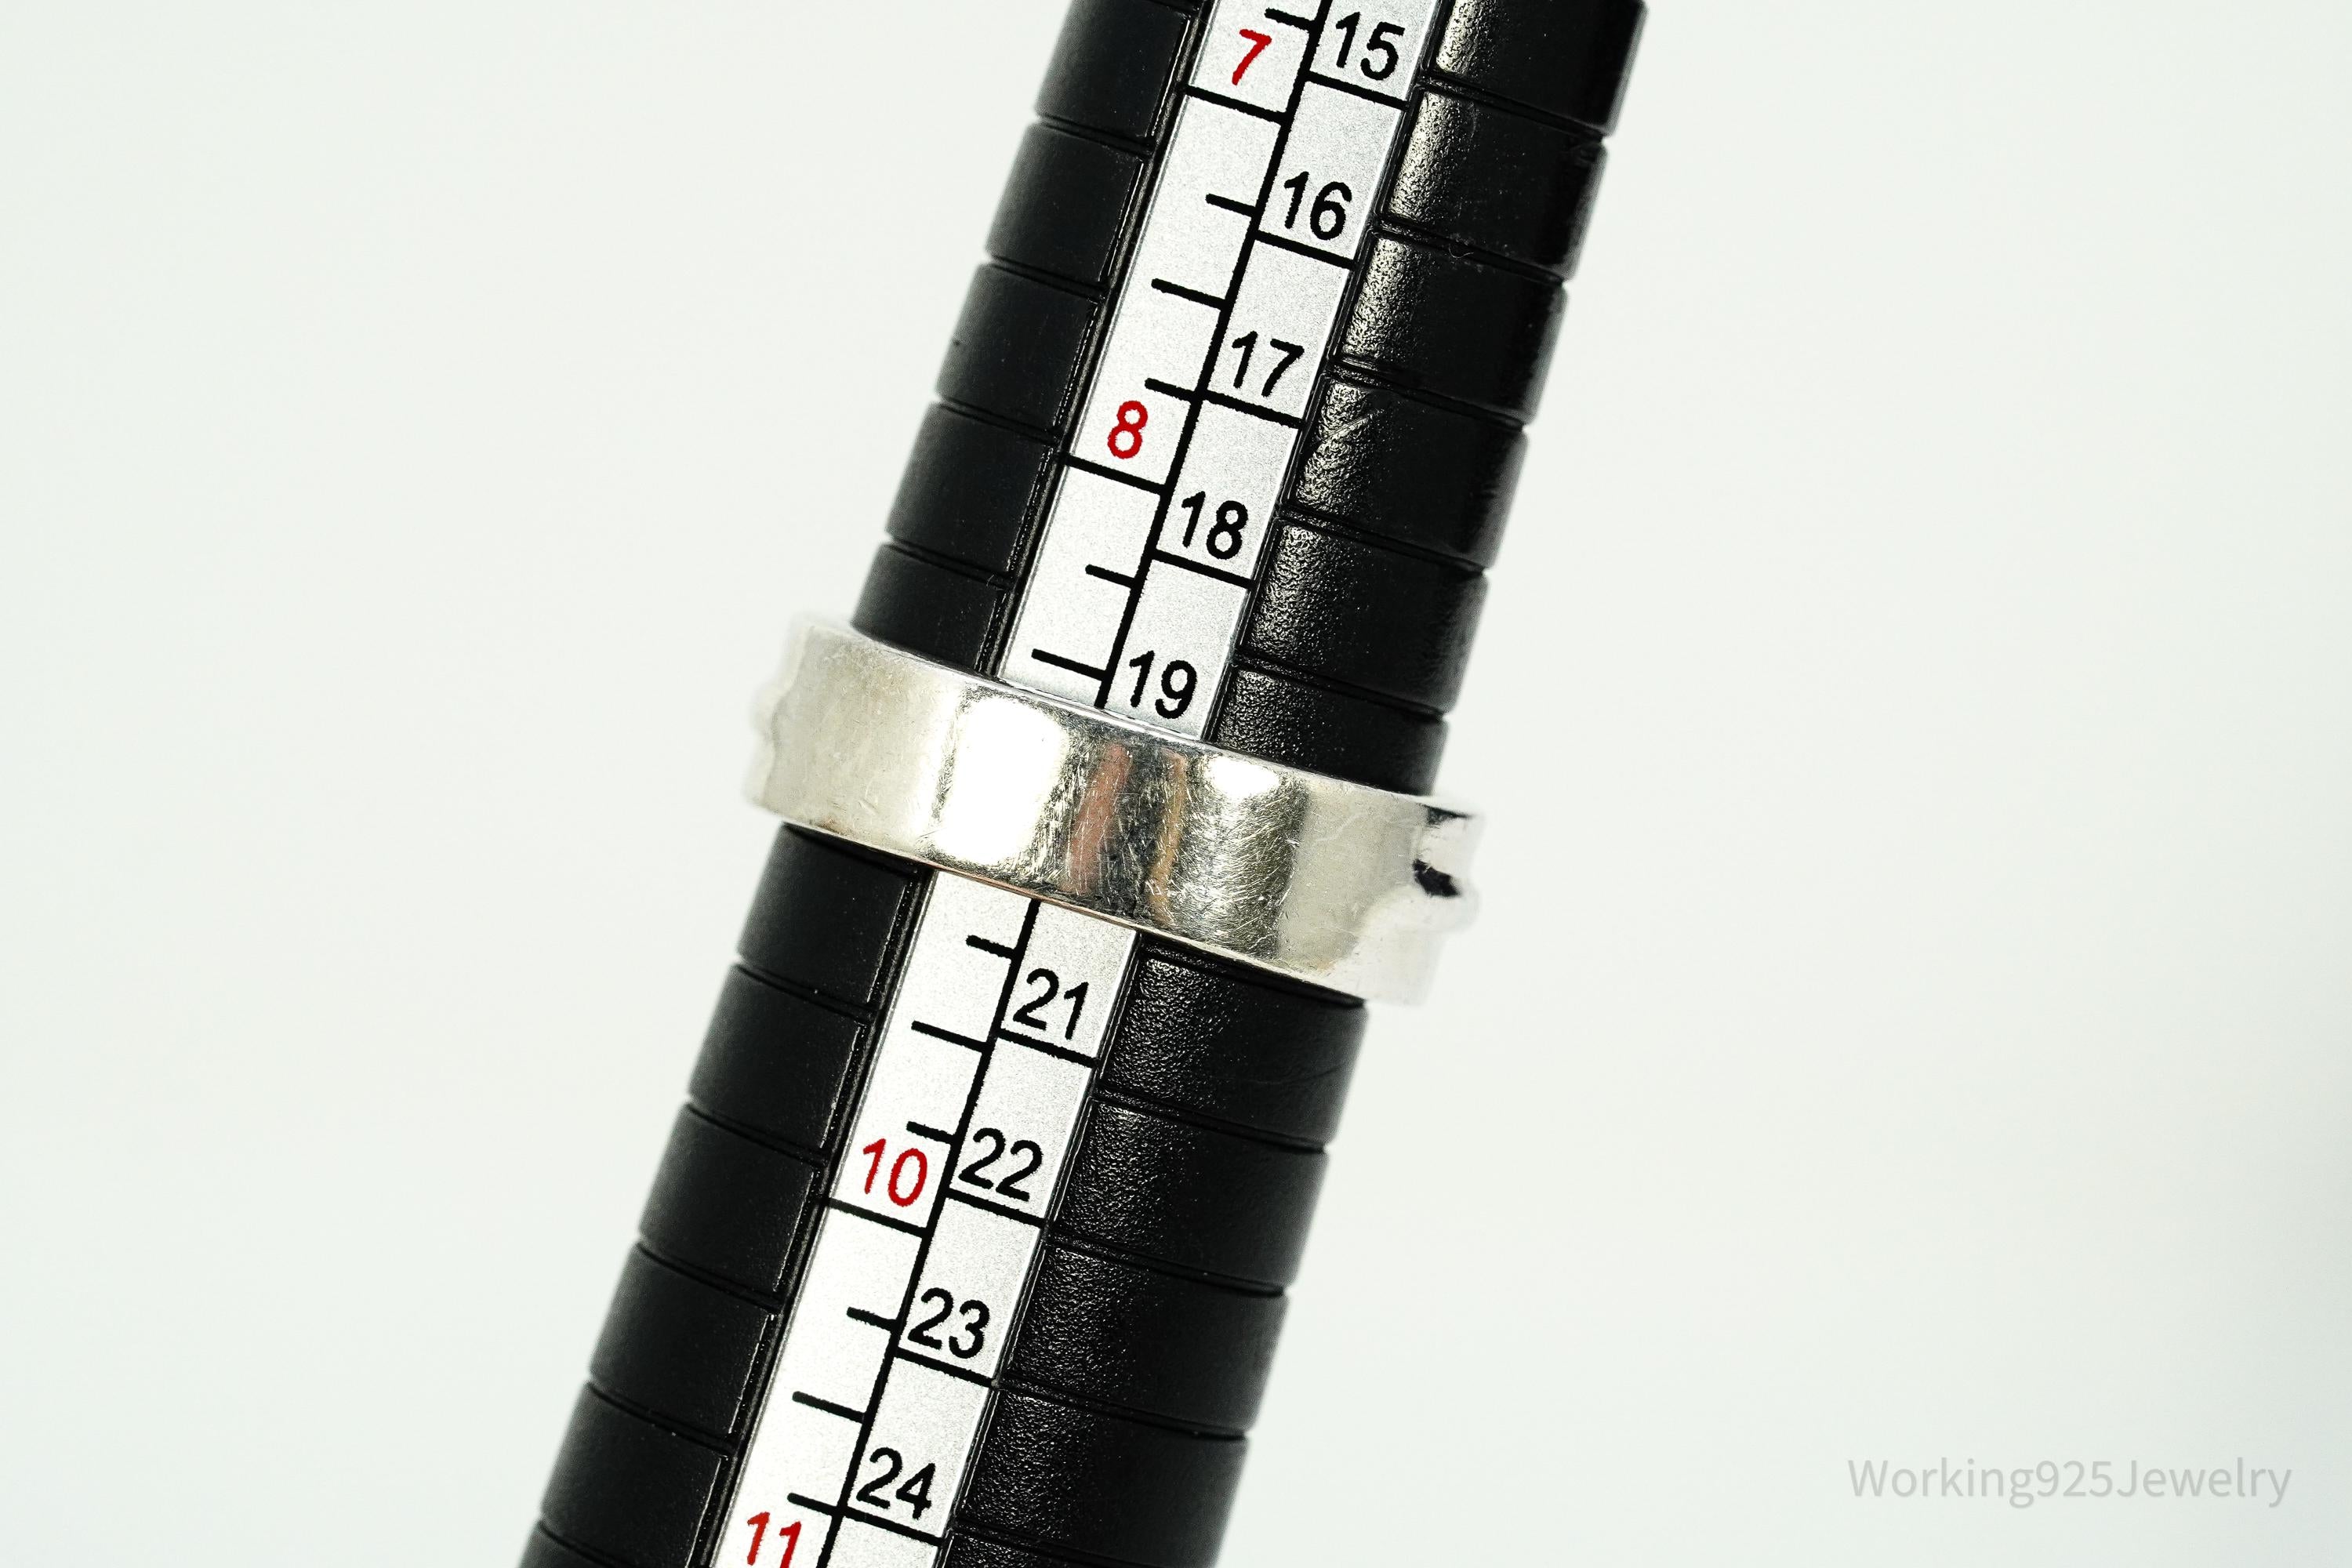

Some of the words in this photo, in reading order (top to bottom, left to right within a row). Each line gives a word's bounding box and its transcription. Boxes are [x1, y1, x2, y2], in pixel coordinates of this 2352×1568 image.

[1231, 28, 1272, 85] 7
[1335, 11, 1406, 82] 15
[1283, 171, 1352, 241] 16
[1231, 330, 1305, 398] 17
[1106, 400, 1149, 460] 8
[1181, 490, 1249, 561] 18
[1128, 650, 1198, 720] 19
[1012, 967, 1090, 1040] 21
[862, 1138, 928, 1207] 10
[957, 1127, 1044, 1203] 22
[907, 1287, 990, 1359] 23
[855, 1446, 936, 1521] 24
[746, 1511, 802, 1568] 11
